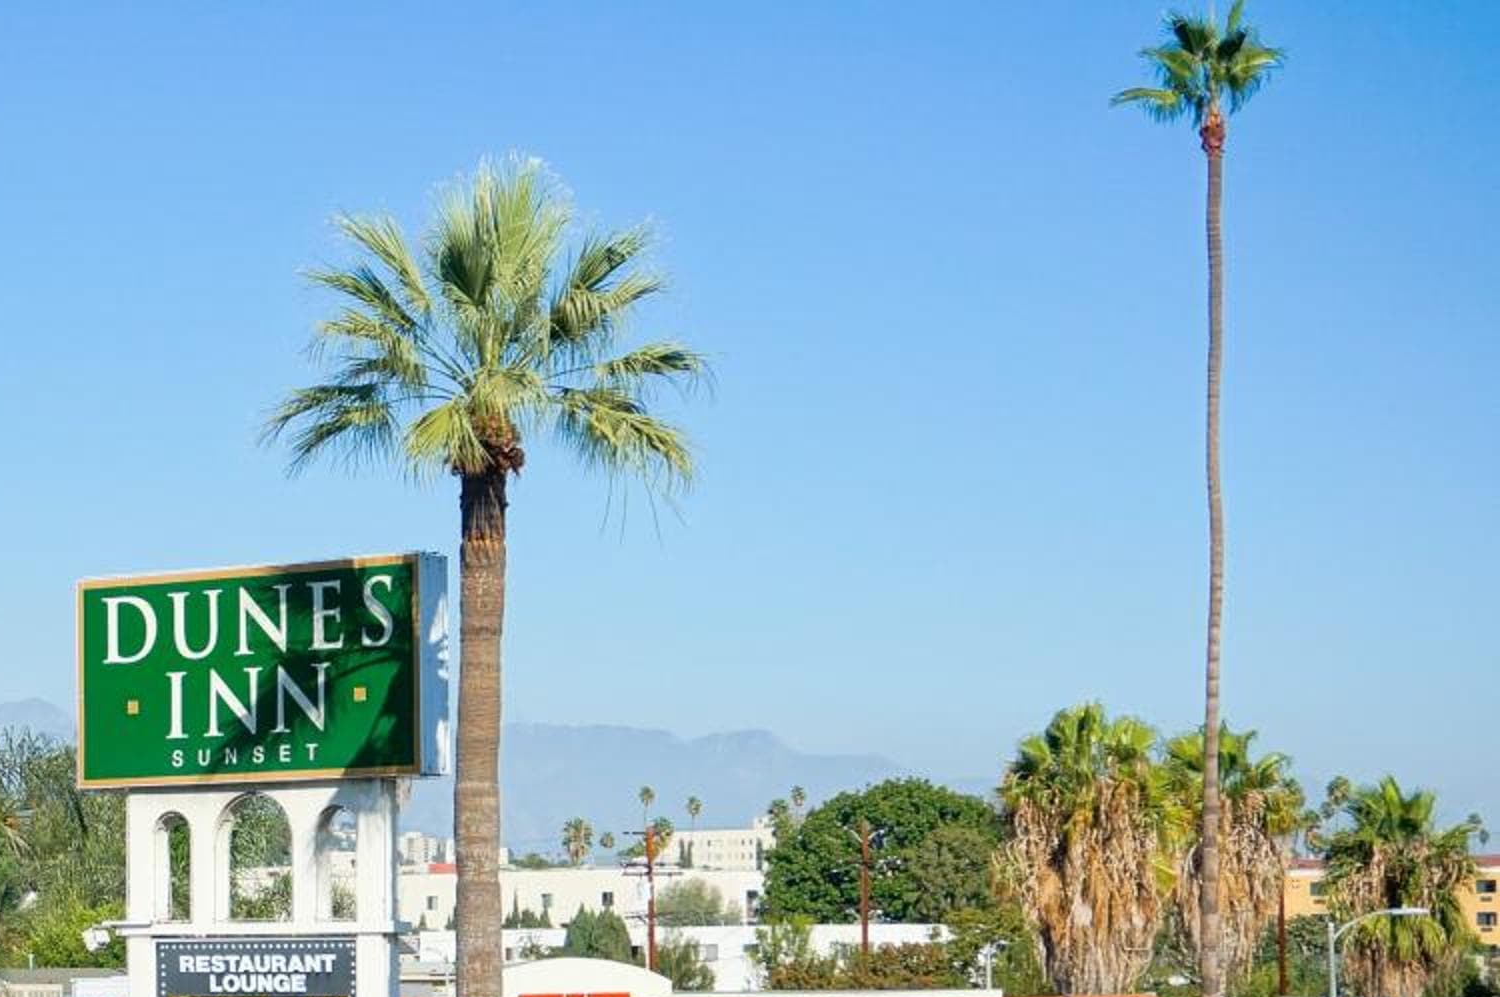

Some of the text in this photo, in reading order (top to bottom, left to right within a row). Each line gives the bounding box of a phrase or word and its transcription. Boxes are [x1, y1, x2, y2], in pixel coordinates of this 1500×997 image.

[102, 574, 394, 665] DUNES
[165, 661, 332, 740] INN
[171, 743, 319, 768] SUNSET
[179, 954, 336, 973] RESTAURANT
[209, 974, 307, 993] LOUNGE
